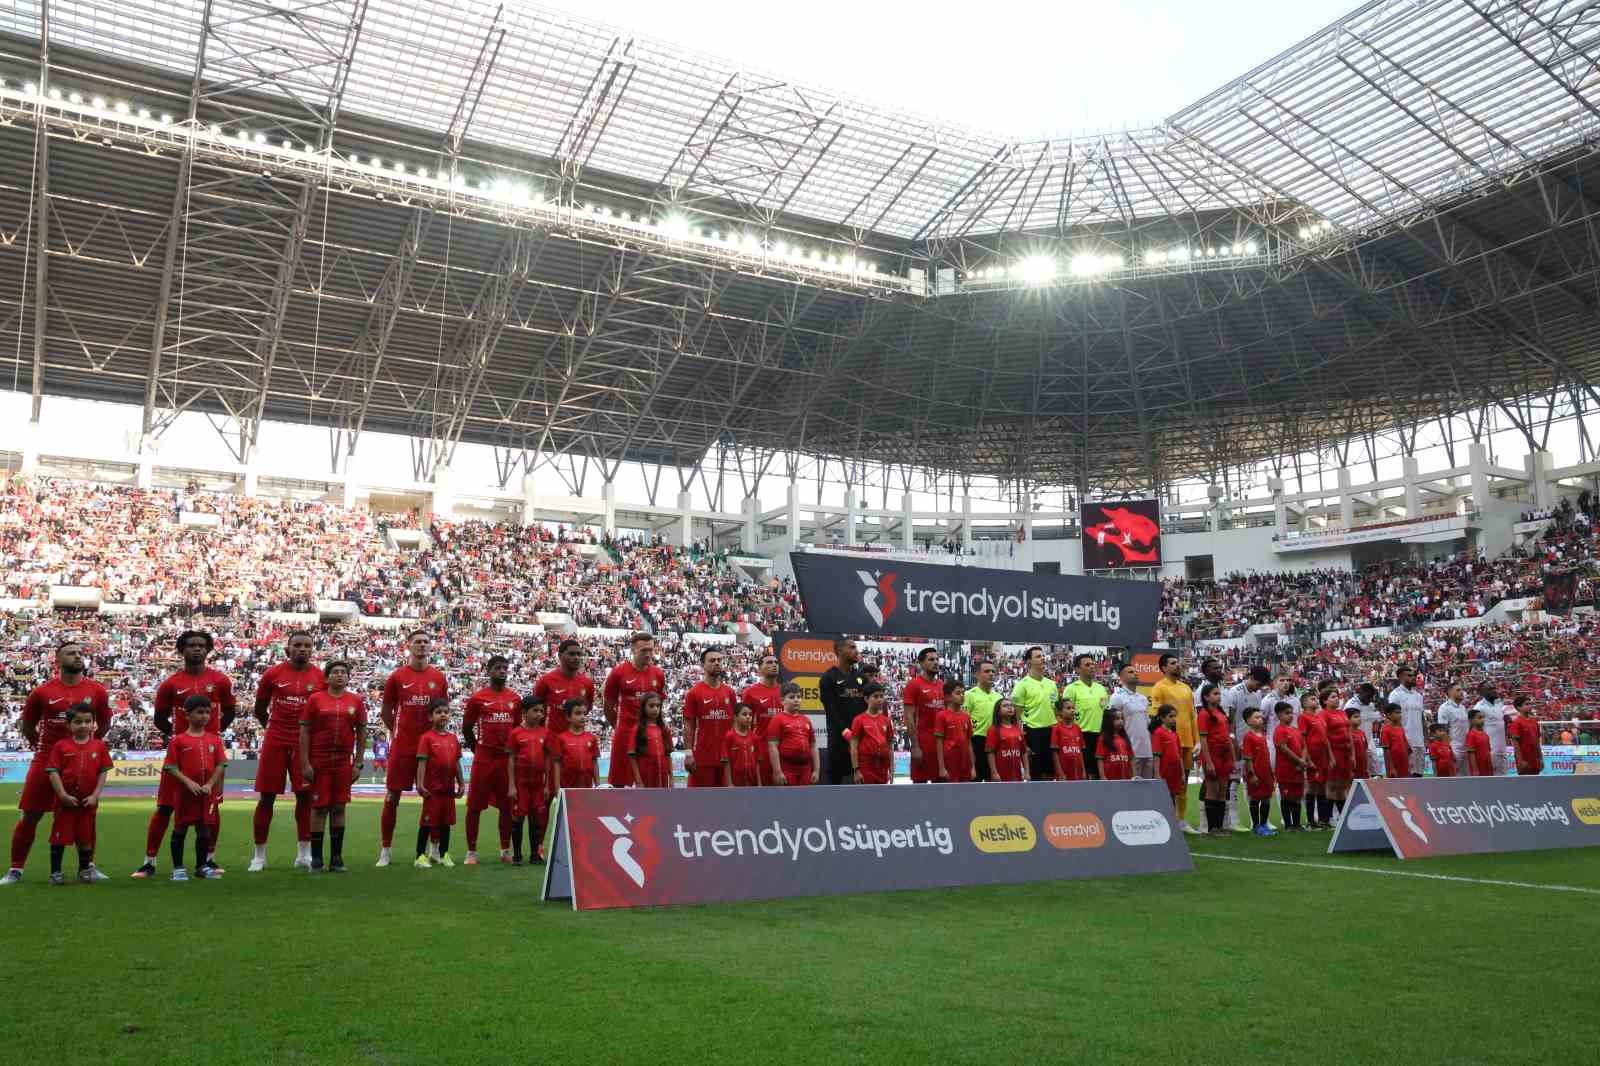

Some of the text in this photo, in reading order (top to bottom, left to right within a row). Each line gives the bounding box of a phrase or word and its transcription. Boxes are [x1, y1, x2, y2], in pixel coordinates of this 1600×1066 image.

[904, 582, 1027, 623] trendyol
[1050, 822, 1100, 838] trendyol
[1427, 800, 1507, 828] trendyol
[673, 819, 836, 861] trendyol
